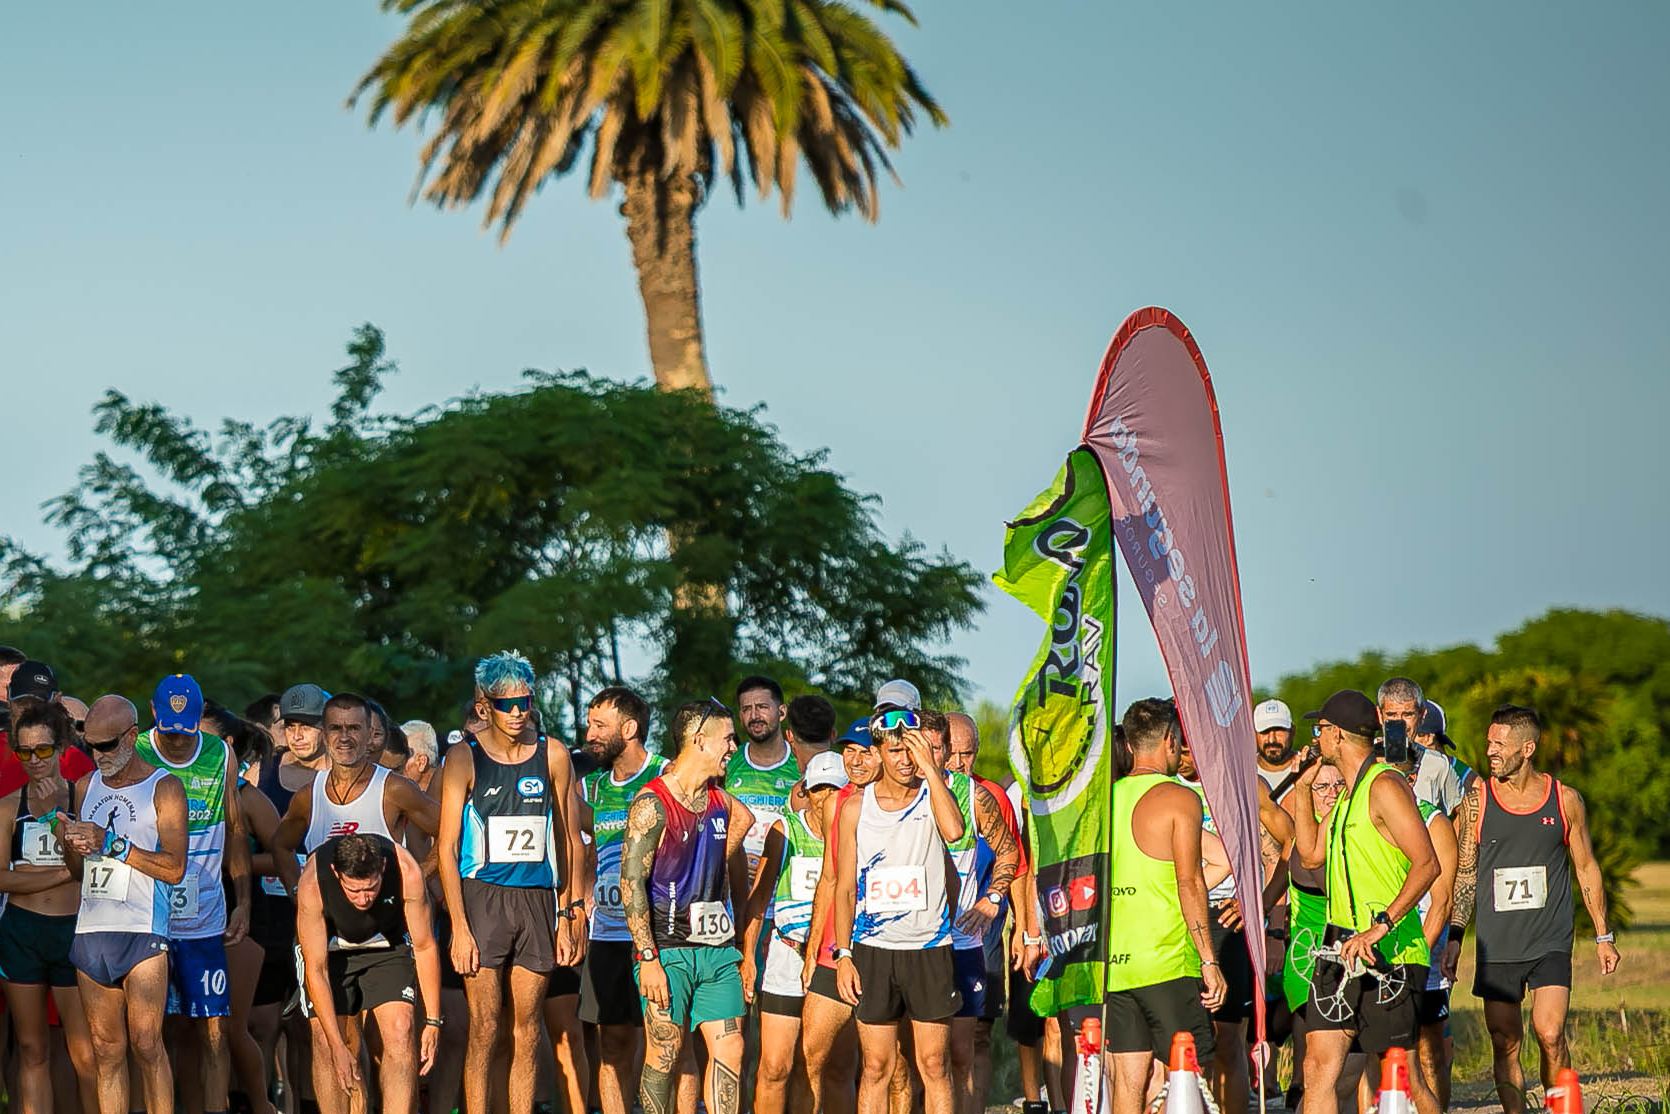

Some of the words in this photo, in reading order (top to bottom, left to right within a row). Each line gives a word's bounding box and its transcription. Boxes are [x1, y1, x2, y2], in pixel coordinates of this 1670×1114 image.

[505, 828, 536, 852] 72
[89, 865, 115, 889] 17
[870, 877, 922, 901] 504
[1504, 879, 1534, 901] 71
[696, 912, 731, 937] 130
[1109, 953, 1132, 965] AFF
[200, 968, 227, 997] 10
